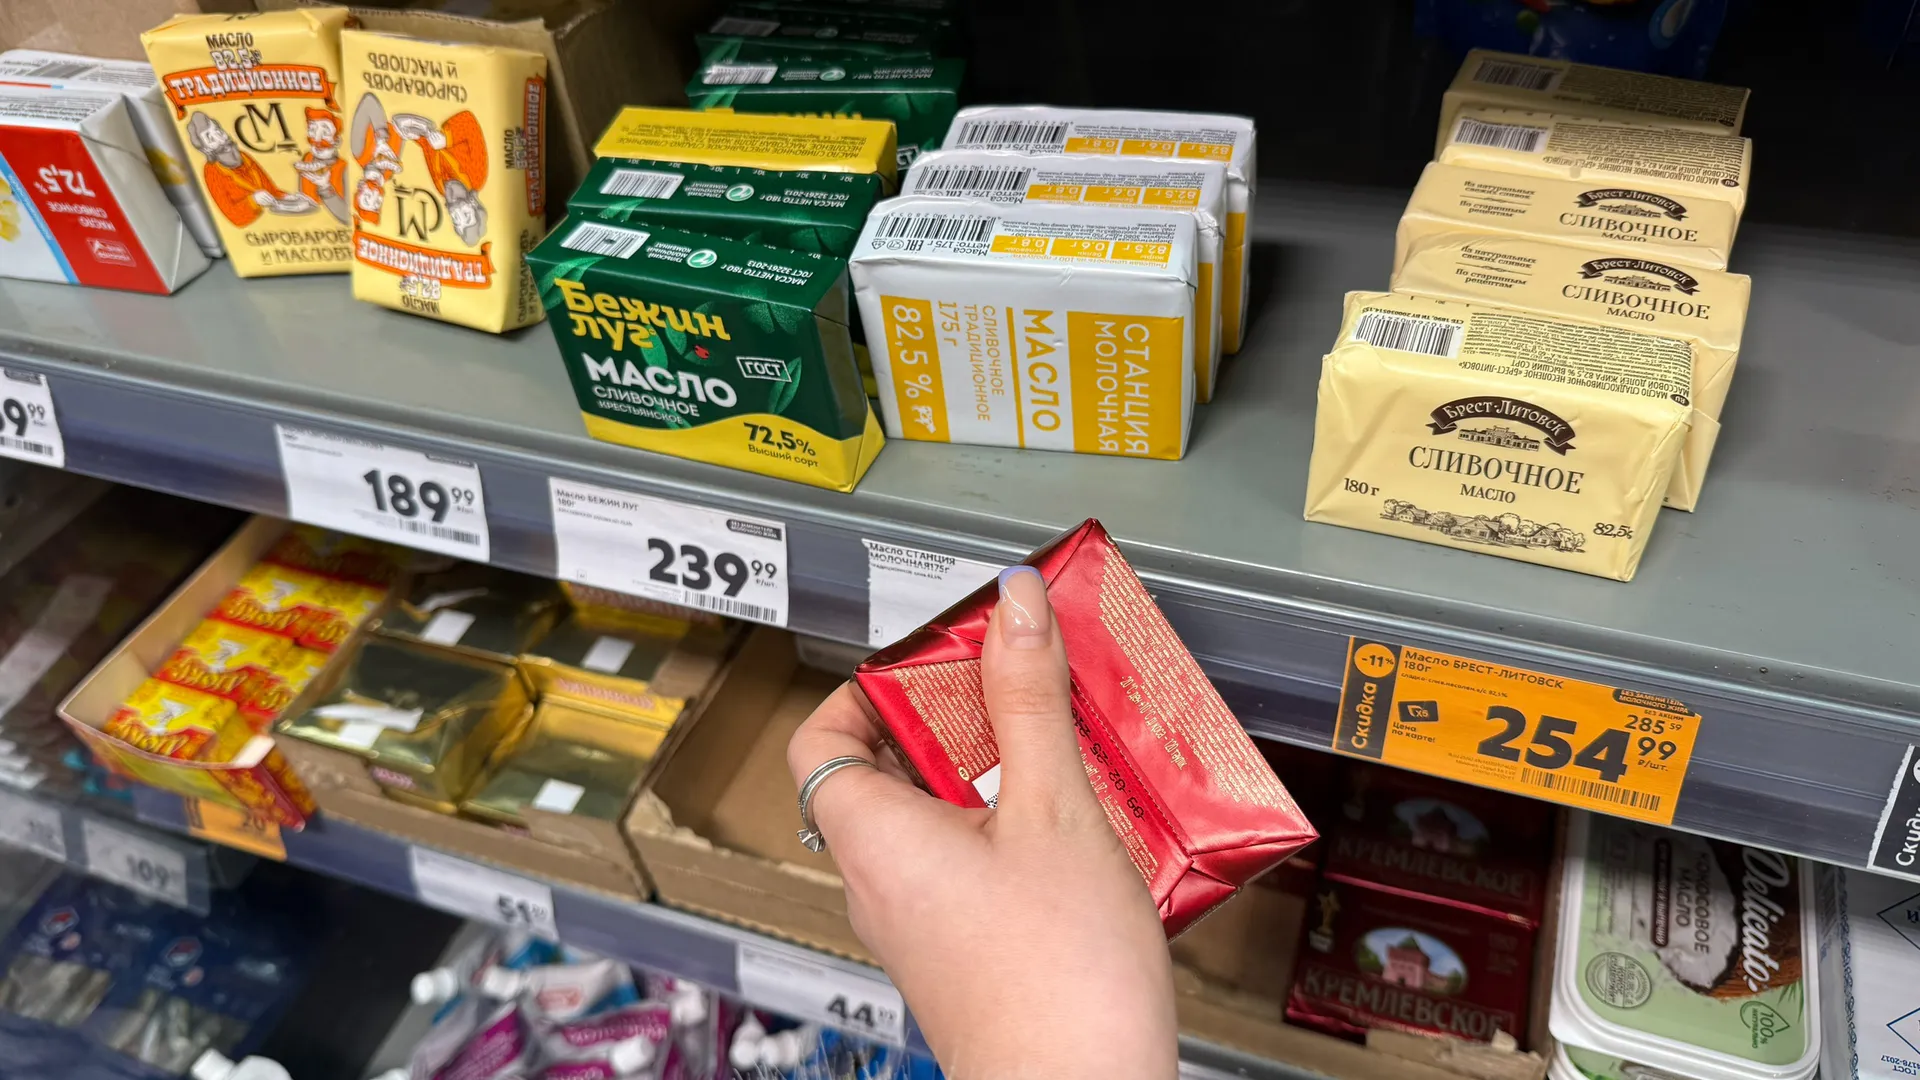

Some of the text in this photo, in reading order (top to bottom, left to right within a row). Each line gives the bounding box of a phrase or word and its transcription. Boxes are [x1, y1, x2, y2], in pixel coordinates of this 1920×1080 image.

[206, 32, 254, 49] МАСЛО
[367, 52, 443, 79] МАСЛОВЪ
[170, 70, 323, 100] ТРАДИЦИОННОЕ
[363, 71, 468, 103] СЫРОВАРОВЪ
[1465, 186, 1531, 200] свежих сливок
[1477, 183, 1536, 196] натуральных
[783, 198, 813, 206] НЕТТО
[814, 200, 846, 208] МАССА
[990, 195, 1024, 204] Масса
[1559, 212, 1698, 243] СЛИВОЧНОЕ
[934, 240, 953, 249] 175
[1601, 232, 1647, 243] МАСЛО
[358, 237, 487, 284] ТРАДИЦИОННОЕ
[953, 247, 988, 256] Масса
[1462, 252, 1532, 269] свежих сливок
[1474, 249, 1537, 264] натуральных
[727, 265, 807, 286] МАССА НЕТТО 180
[747, 260, 814, 279] ГОСТ 32261-2013
[1455, 268, 1527, 286] По старинным
[1464, 276, 1513, 289] рецептам
[402, 295, 440, 313] МАСЛО
[554, 278, 731, 341] Бежин
[1562, 283, 1711, 321] СЛИВОЧНОЕ
[938, 301, 960, 346] 175 г
[1606, 307, 1655, 322] МАСЛО
[982, 305, 1004, 396] СЛИВОЧНОЕ
[745, 361, 781, 377] ГОСТ
[964, 304, 990, 421] ТРАДИЦИОННОЕ
[1023, 309, 1061, 432] МАСЛО
[1459, 360, 1523, 378] «БРЕСТ-ЛИТОВСК»
[1510, 359, 1531, 369] СОРТ
[1532, 363, 1567, 375] ВЫСШИЙ
[581, 352, 737, 408] МАСЛО
[1524, 370, 1566, 384] НЕСОЛЕНОЕ
[1567, 376, 1640, 396] СЛАДКОСЛИВОЧНОЕ
[1595, 374, 1618, 384] ЖИРА
[1619, 377, 1646, 388] ДОЛЕЙ
[1095, 321, 1119, 453] МОЛОЧНАЯ
[1122, 323, 1150, 455] СТАНЦИЯ
[1641, 388, 1668, 400] МАСЛО
[1648, 382, 1690, 398] МАССОВОЙ
[592, 385, 701, 418] СЛИВОЧНОЕ
[598, 401, 684, 424] КРЕСТЬЯНСКОЕ
[743, 422, 816, 457] 72,5%
[748, 444, 819, 468] Высший сорт
[1408, 446, 1585, 495] СЛИВОЧНОЕ
[363, 468, 475, 523] 189 99
[1343, 478, 1380, 496] 180 г
[1459, 484, 1516, 504] МАСЛО
[869, 542, 955, 565] Масло СТАНЦИЯ
[647, 538, 749, 598] 239
[751, 559, 777, 579] 99
[1362, 654, 1394, 668] -11%
[1403, 661, 1431, 673] 180г
[1405, 651, 1564, 689] Масло БРЕСТ-ЛИТОВСК
[1619, 695, 1688, 714] МОЛОЧНОГО ЖИРА
[1351, 682, 1378, 749] Скидка
[1624, 714, 1665, 735] 285
[1393, 721, 1418, 732] Цена
[1405, 731, 1436, 744] карте!
[1477, 704, 1631, 784] 254
[1637, 736, 1677, 760] 99
[1676, 866, 1690, 928] МАСЛО
[1742, 847, 1789, 984] Delicato
[1304, 966, 1506, 1037] КРЕМЛЕВСКОЕ
[1892, 1065, 1917, 1076] ГОСТ
